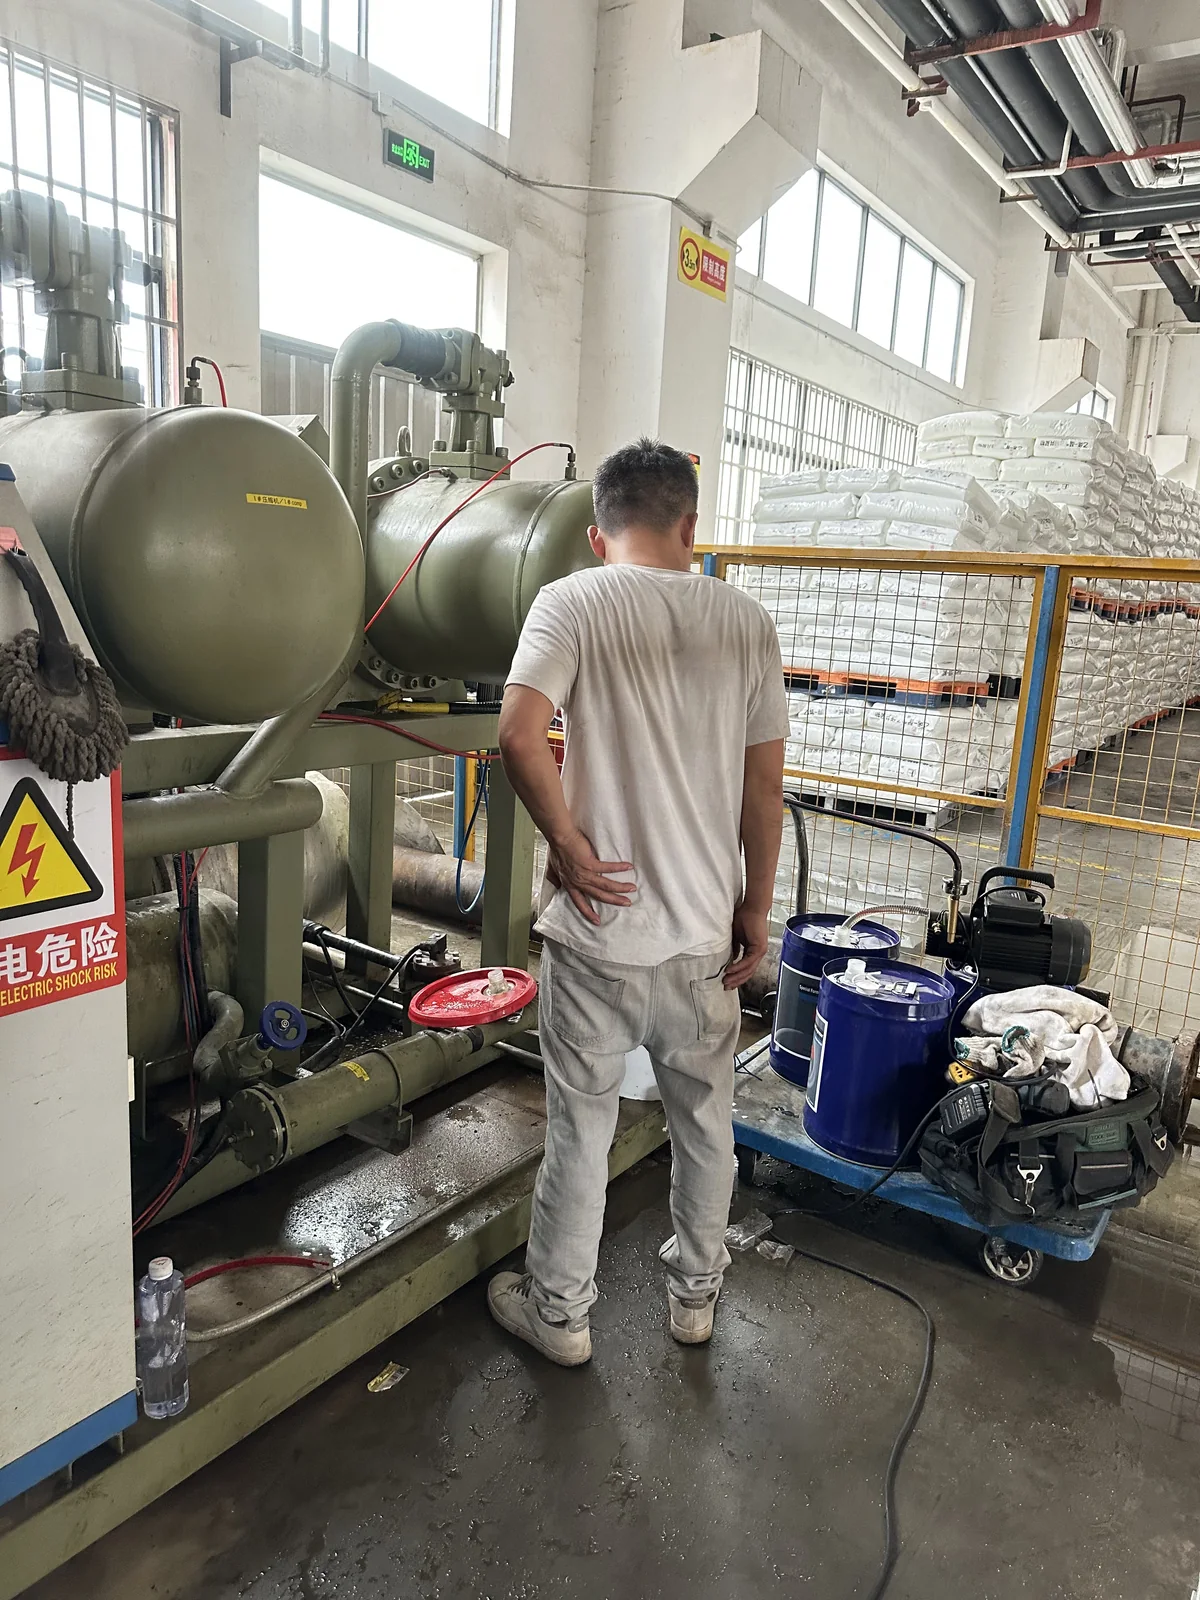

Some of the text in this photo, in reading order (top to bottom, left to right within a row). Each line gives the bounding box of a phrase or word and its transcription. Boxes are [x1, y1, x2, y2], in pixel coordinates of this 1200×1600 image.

[0, 961, 118, 1007] ELECTRIC SHOCK RISK
